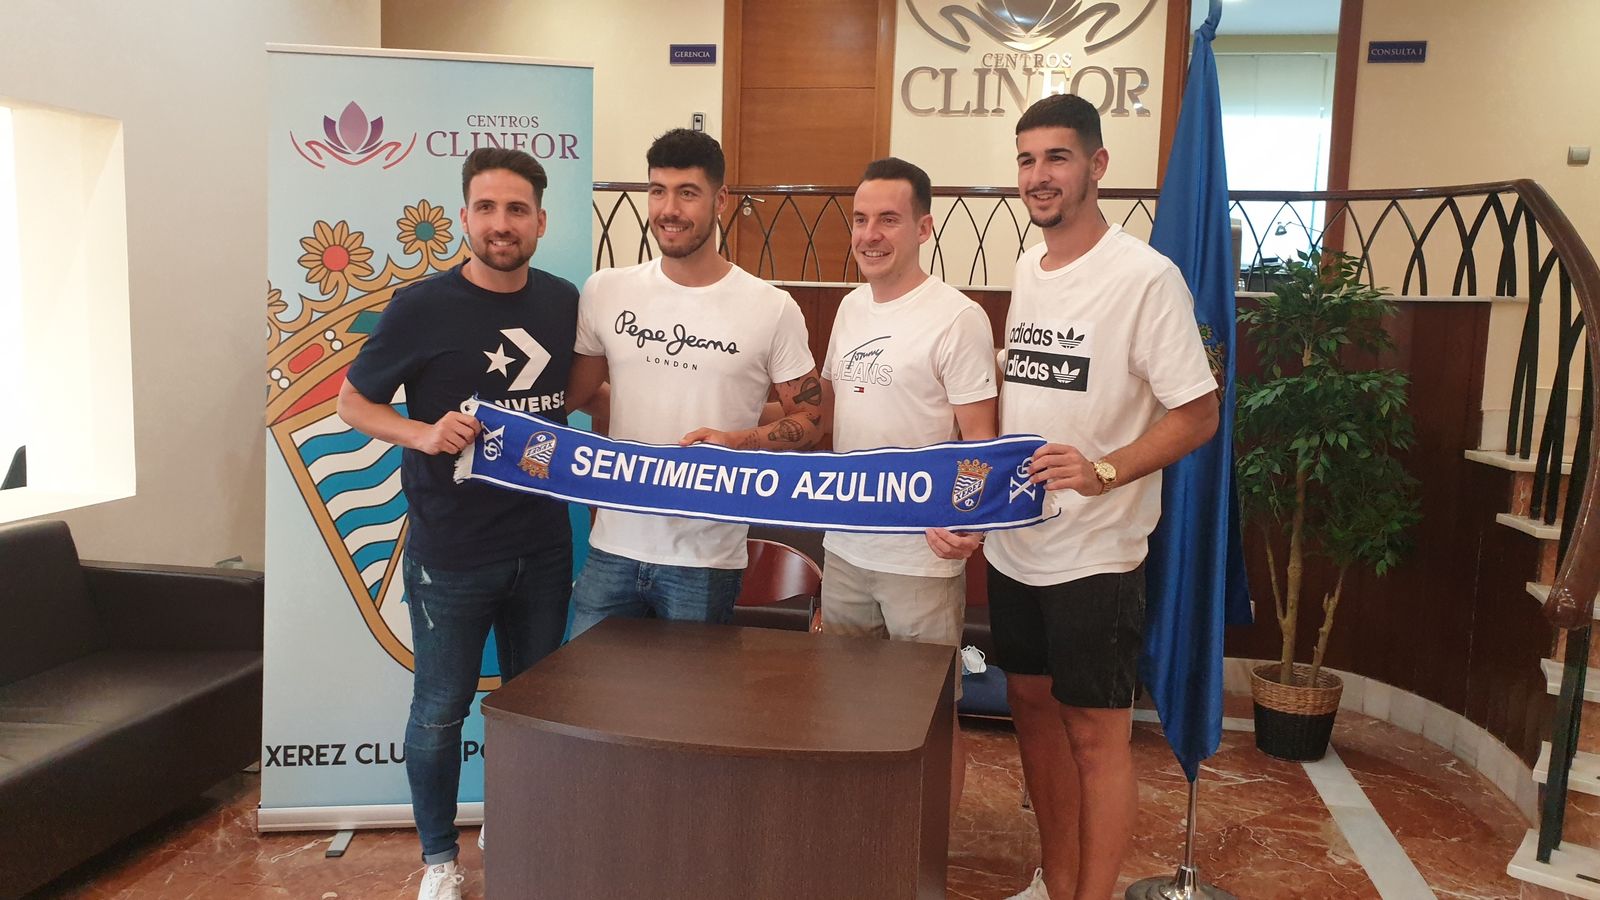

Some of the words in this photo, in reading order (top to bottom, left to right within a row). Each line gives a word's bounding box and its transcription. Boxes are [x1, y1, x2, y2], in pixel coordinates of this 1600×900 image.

[982, 53, 1072, 69] CENTROS
[1370, 48, 1416, 56] CONSULTA
[900, 66, 1151, 117] CLINFOR
[466, 115, 539, 128] CENTROS
[426, 130, 580, 159] CLINFOR
[615, 310, 667, 348] Pepe
[666, 324, 740, 356] Jeans
[1010, 322, 1053, 346] adidas
[646, 356, 698, 370] LONDON
[843, 335, 892, 372] Tommy
[833, 360, 893, 386] JEANS
[1006, 354, 1050, 381] didas
[495, 391, 564, 413] VERSE
[571, 446, 779, 497] SENTIMIENTO
[791, 471, 933, 503] AZULINO
[265, 744, 346, 767] XEREZ
[355, 742, 406, 765] CLU
